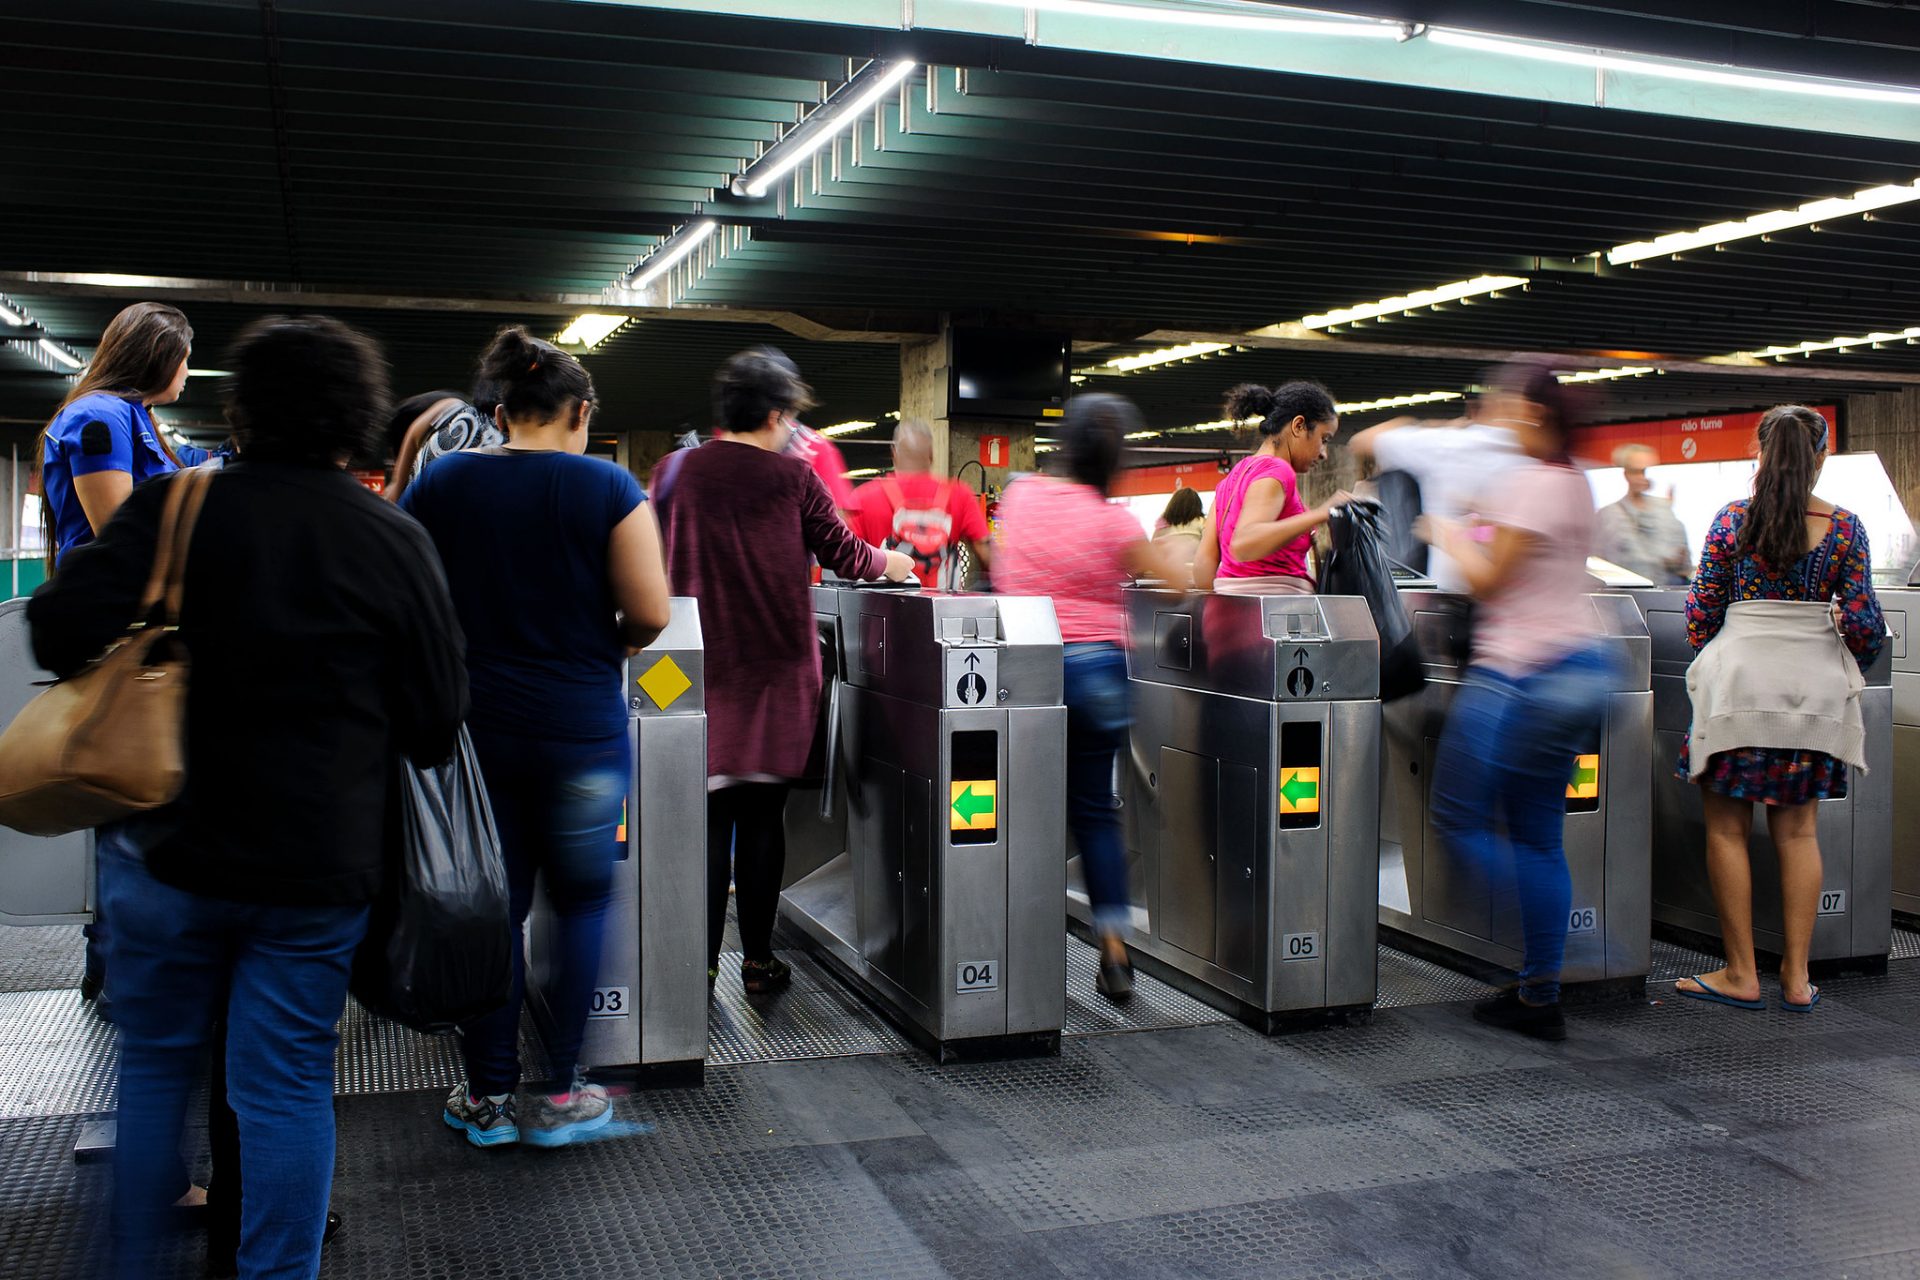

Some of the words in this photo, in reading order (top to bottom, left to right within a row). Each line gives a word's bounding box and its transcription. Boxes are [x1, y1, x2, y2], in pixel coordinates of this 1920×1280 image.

[1700, 418, 1723, 430] fume
[1822, 893, 1841, 910] 07
[1570, 910, 1594, 928] 06
[1290, 936, 1313, 955] 05
[962, 964, 992, 985] 04
[591, 990, 622, 1012] 03
